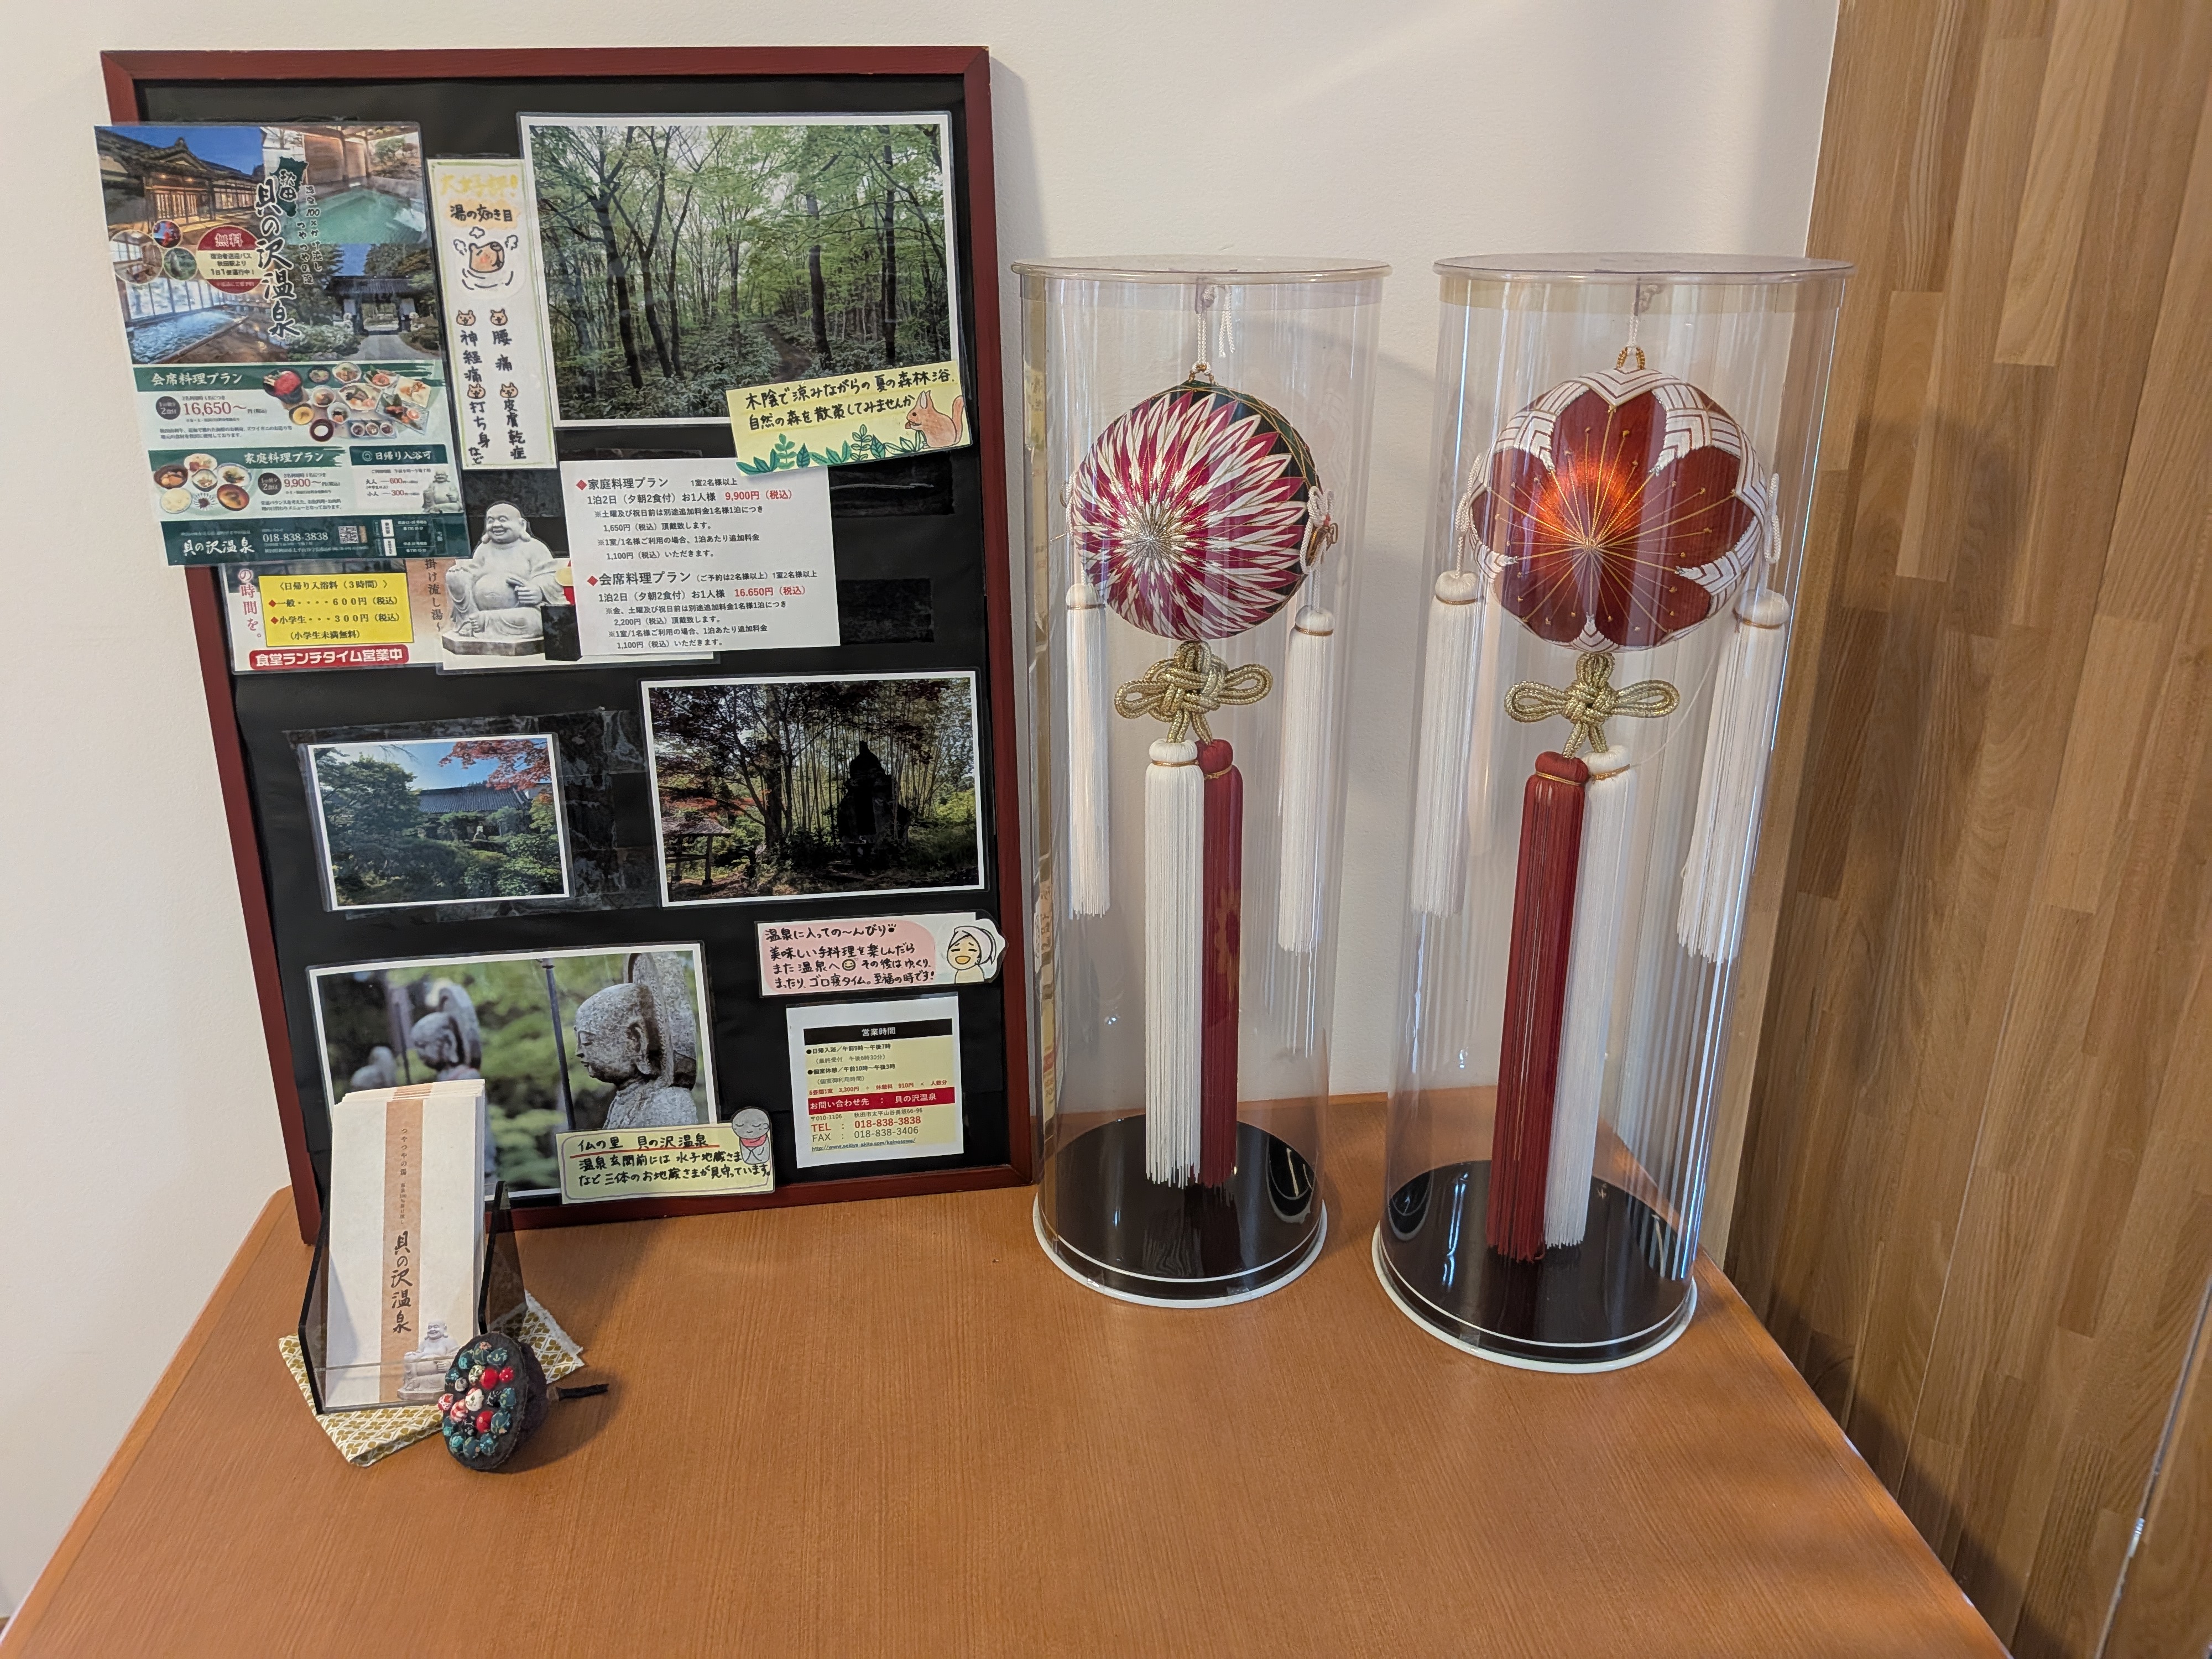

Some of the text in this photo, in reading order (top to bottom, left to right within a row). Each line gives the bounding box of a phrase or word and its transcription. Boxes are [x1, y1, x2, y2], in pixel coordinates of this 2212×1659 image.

[278, 168, 298, 201] 秋田
[450, 204, 513, 222] 湯の効き目
[215, 233, 243, 247] 無料
[255, 177, 301, 339] 貝の沢温泉
[460, 330, 483, 383] 神経痛
[492, 328, 513, 372] 腰痛
[151, 372, 243, 386] 会席料理プラン
[749, 395, 916, 431] 自然の森を散策してみませんか
[244, 452, 324, 465] 家庭料理プラン
[375, 450, 432, 461] 日帰り入浴可
[587, 477, 738, 490] 家庭料理プラン 1室2名様以上
[724, 489, 793, 501] 9,900円（税込）
[262, 532, 328, 542] 018-838-3838
[182, 536, 255, 556] 貝の沢温泉
[598, 570, 691, 586] 会席料理プラン
[255, 648, 403, 667] 食堂ランチタイム営業中
[769, 942, 915, 961] 美味しい手料理を楽しんだら
[861, 1026, 896, 1037] 営業時間
[810, 1098, 869, 1110] お問い合わせ先
[895, 1093, 937, 1104] 貝の沢温泉
[811, 1123, 832, 1133] TEL
[854, 1116, 921, 1129] 018-838-3838
[577, 1133, 709, 1152] 仏の里 貝の沢温泉
[812, 1133, 831, 1142] FAX
[854, 1126, 919, 1139] 018-838-3406
[390, 1230, 413, 1334] 貝の沢温泉
